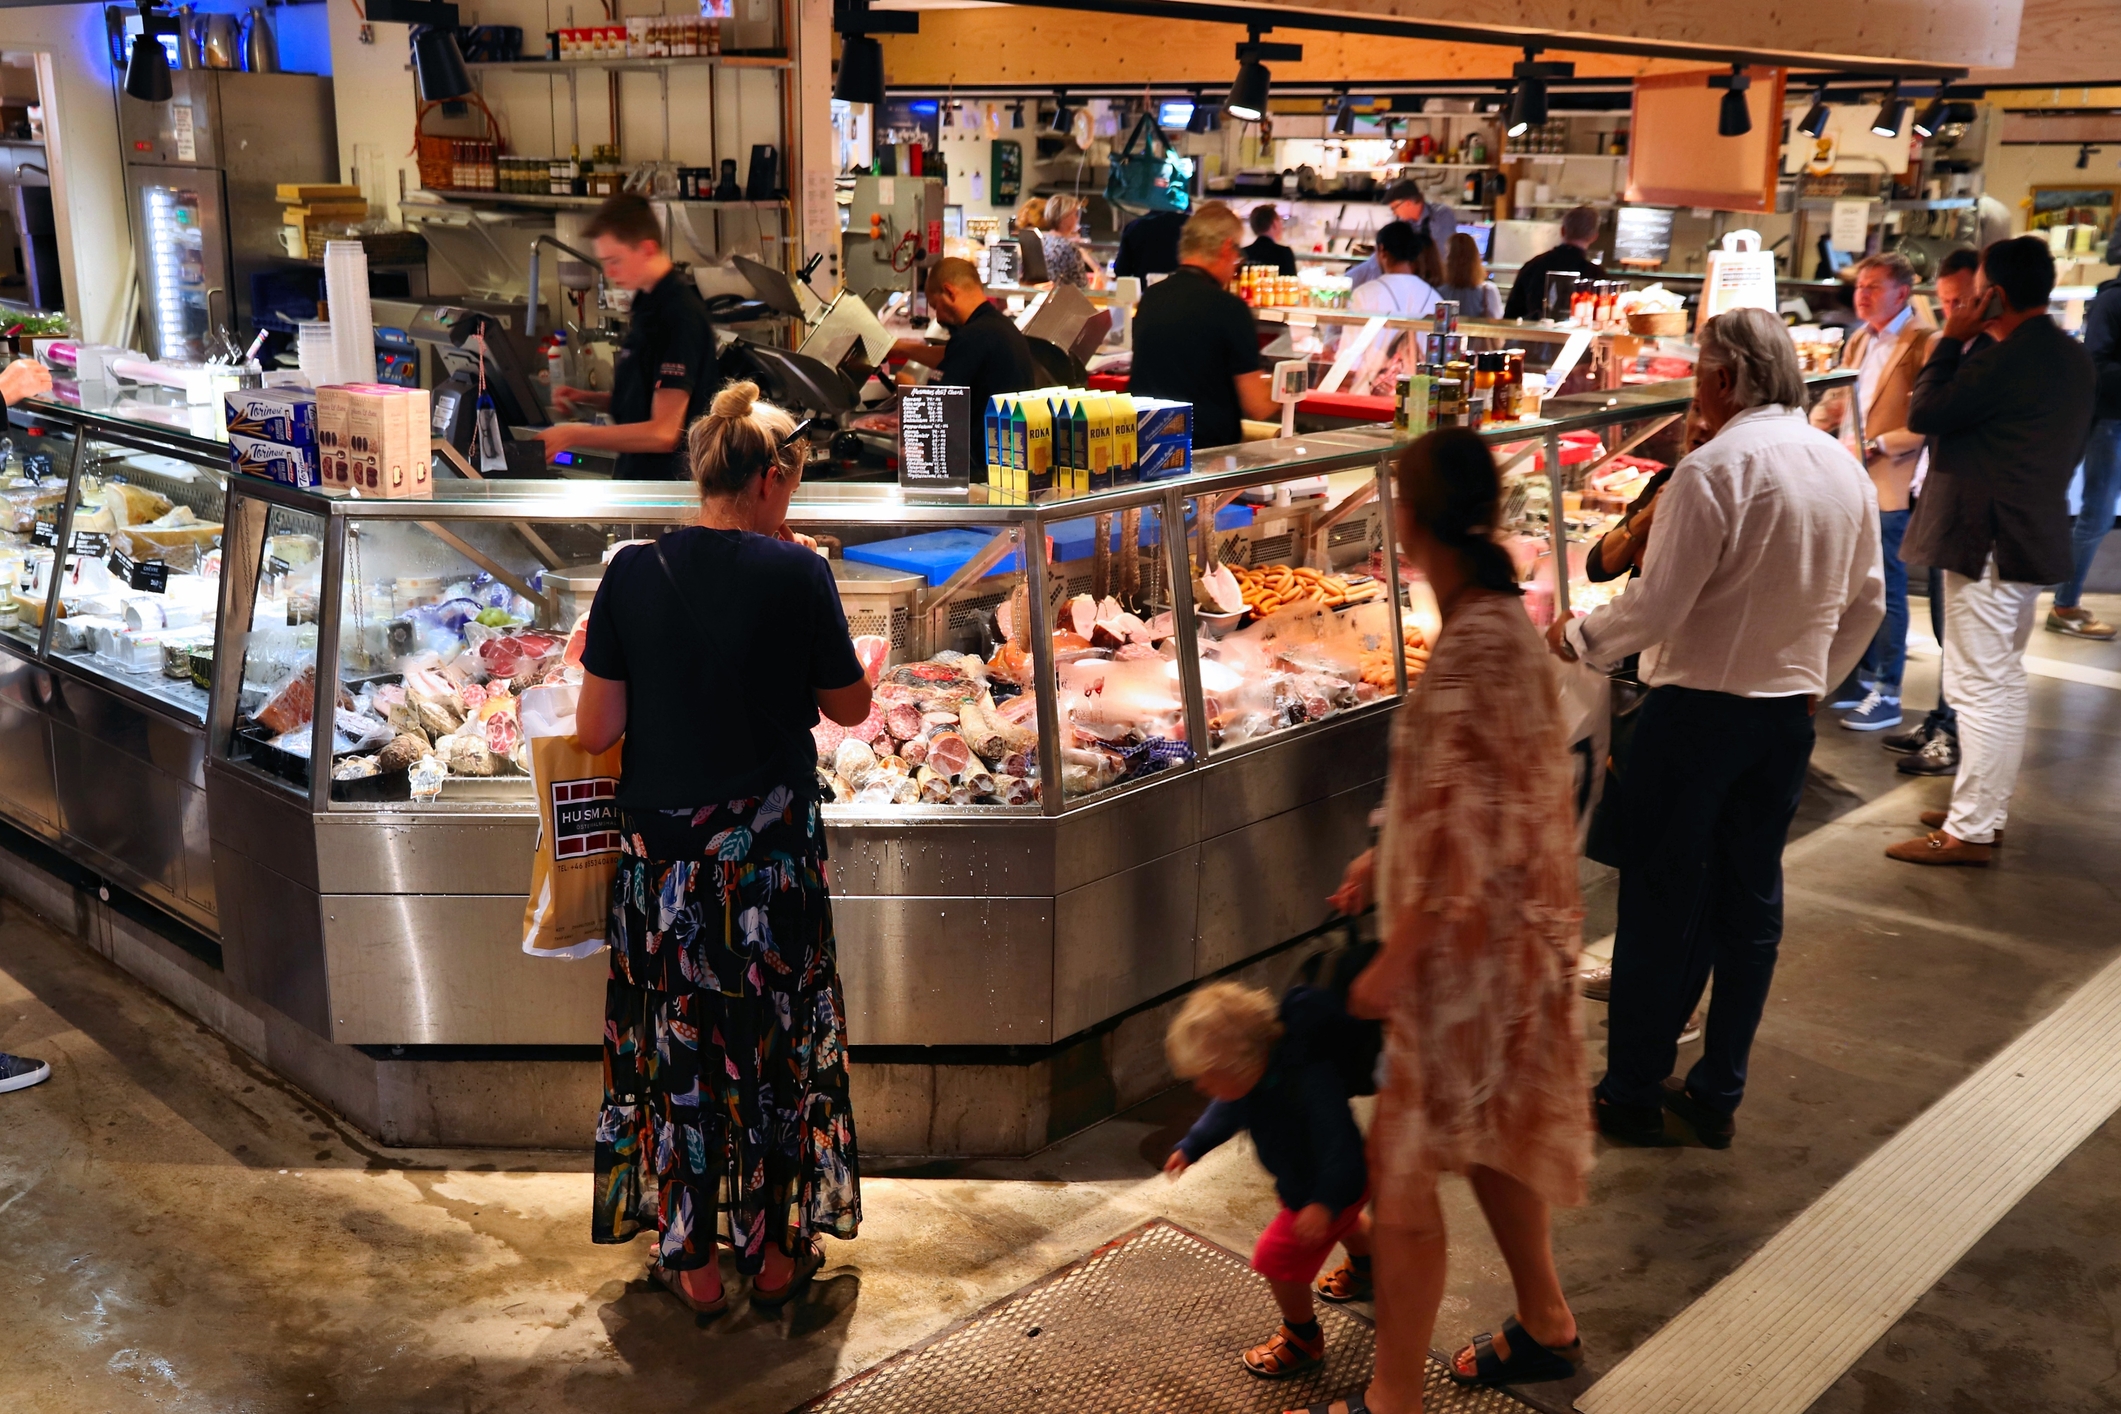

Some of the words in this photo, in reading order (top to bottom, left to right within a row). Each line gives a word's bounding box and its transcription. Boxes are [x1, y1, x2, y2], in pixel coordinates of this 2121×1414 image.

[246, 402, 282, 418] Torinesi
[1029, 428, 1050, 439] ROKA
[1090, 427, 1110, 438] ROKA
[1116, 424, 1136, 435] ROKA
[250, 444, 284, 459] Torinesi
[570, 862, 583, 870] +46
